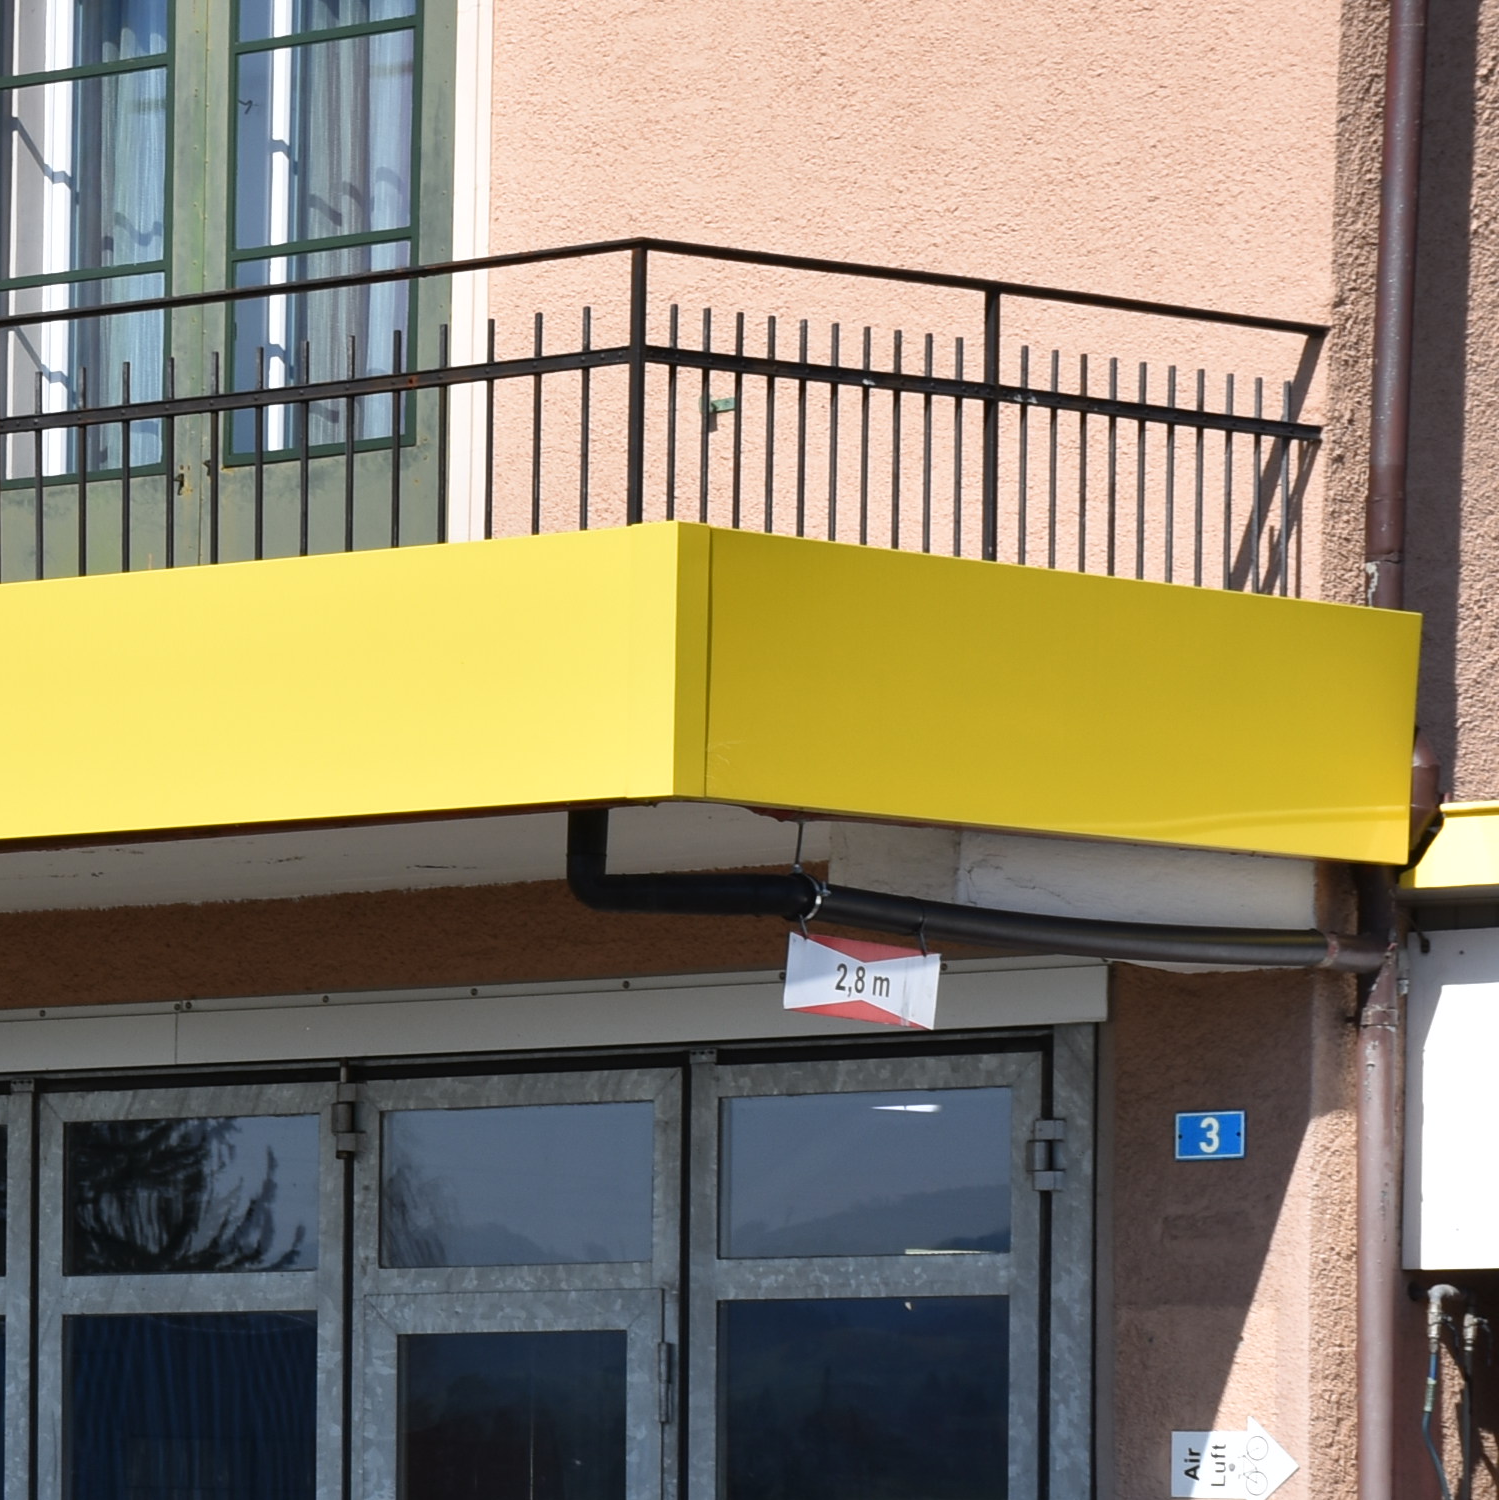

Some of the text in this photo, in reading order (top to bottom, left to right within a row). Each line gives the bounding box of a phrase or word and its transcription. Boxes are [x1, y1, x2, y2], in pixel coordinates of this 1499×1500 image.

[835, 963, 890, 998] 2,8 m
[1199, 1117, 1220, 1153] 3
[1184, 1447, 1201, 1481] Air
[1210, 1444, 1226, 1486] Luft
